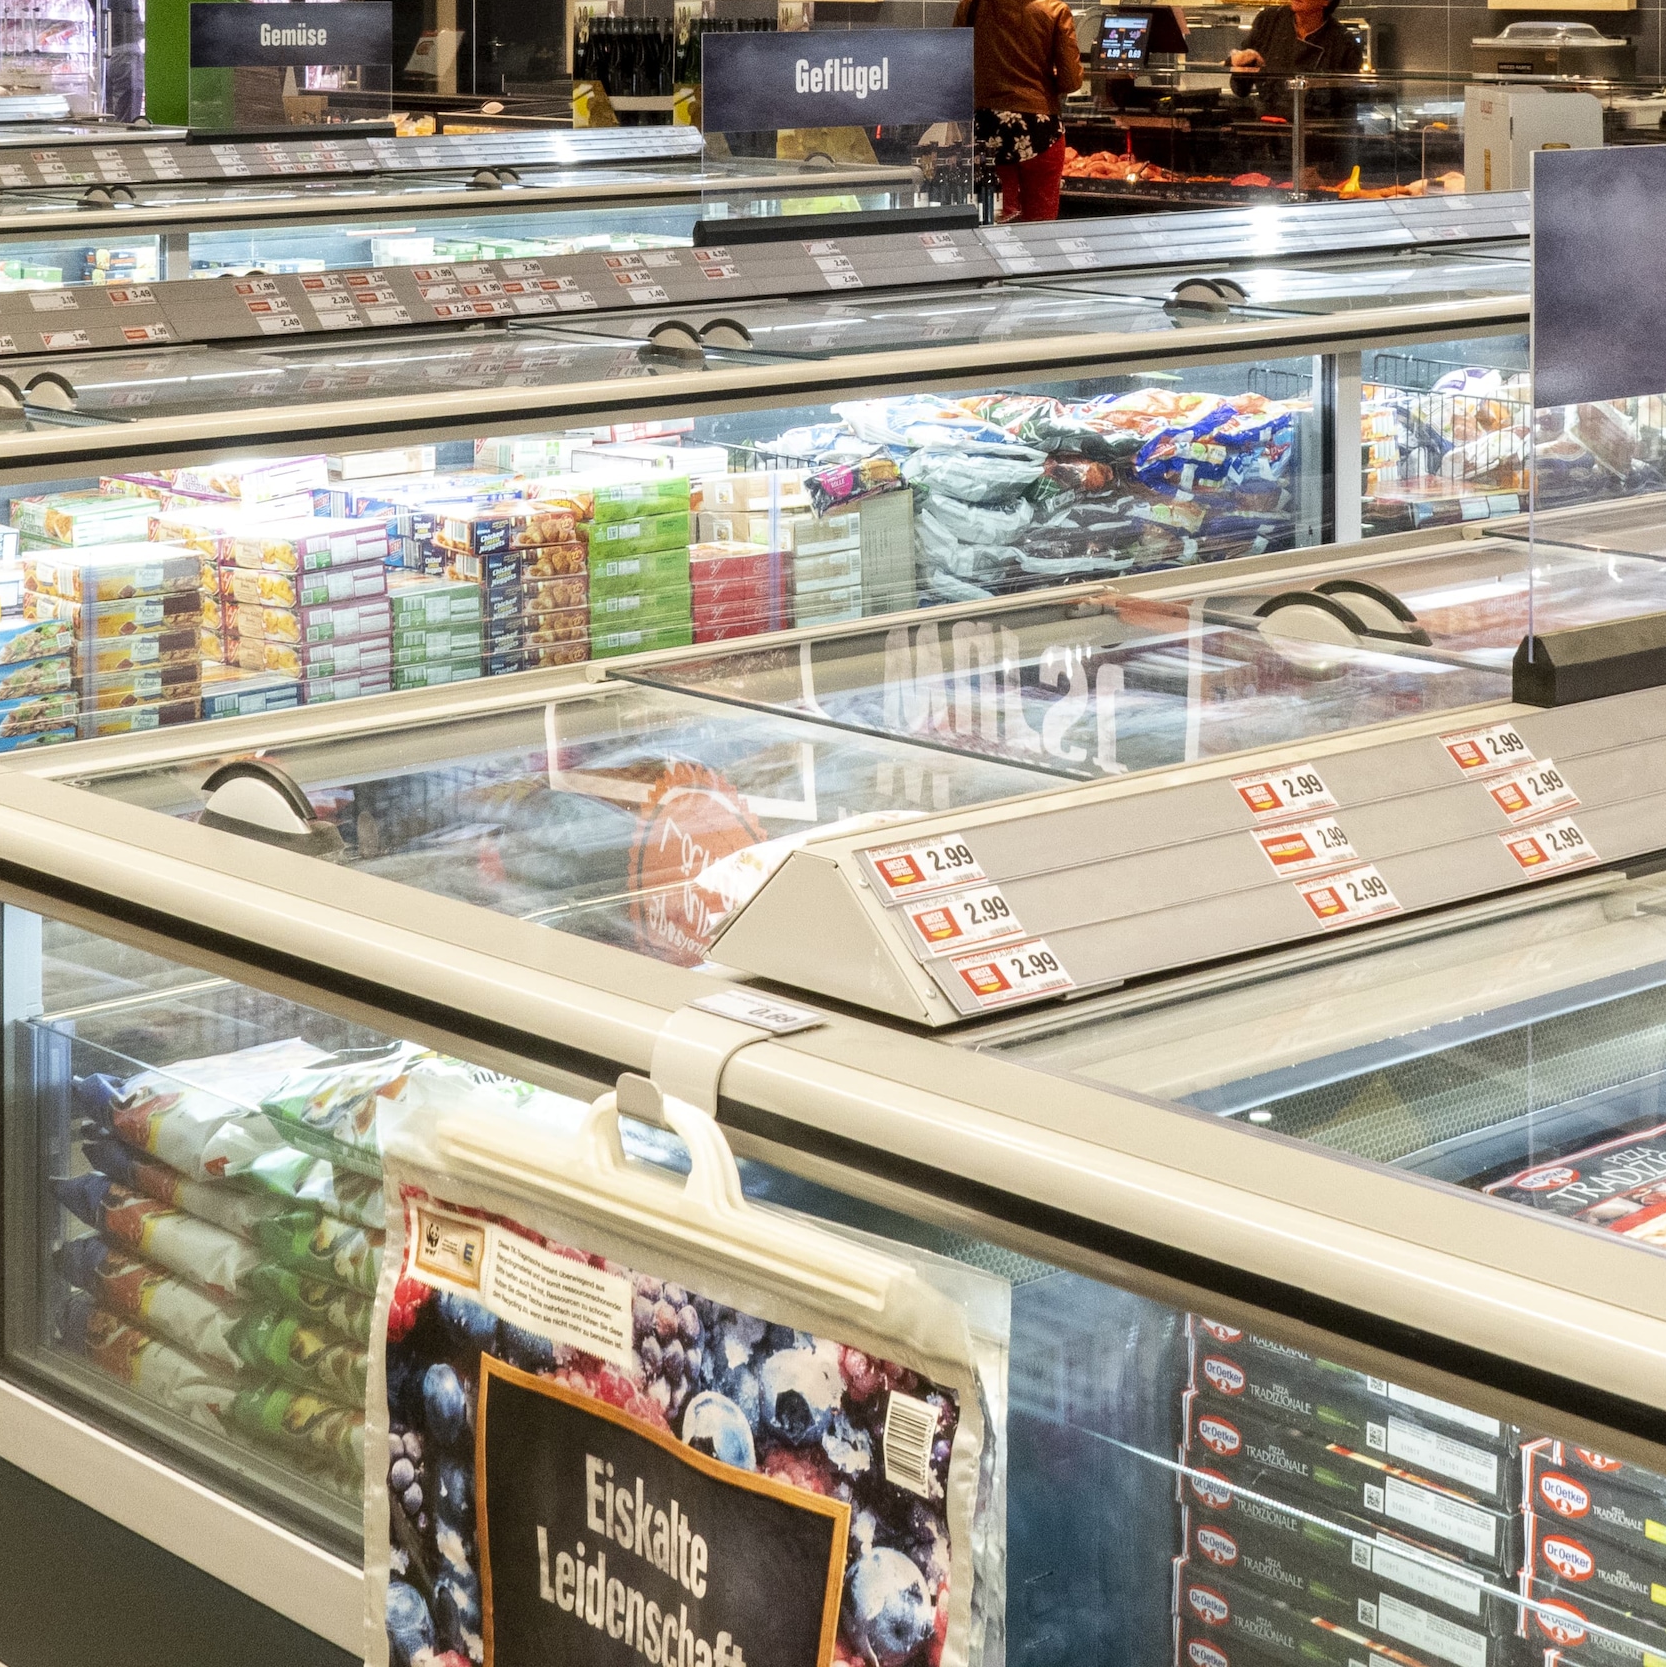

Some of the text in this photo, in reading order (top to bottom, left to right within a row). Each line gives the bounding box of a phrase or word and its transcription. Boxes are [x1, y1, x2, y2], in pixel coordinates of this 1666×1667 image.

[259, 22, 328, 48] Gemüse
[795, 56, 889, 97] Geflügel
[1486, 732, 1524, 755] 2.99
[1282, 774, 1323, 798] 2.99
[1527, 769, 1564, 796] 2.99
[1317, 826, 1349, 849] 2.99
[1546, 827, 1584, 851] 2.99
[926, 844, 974, 871] 2.99
[1346, 876, 1388, 902] 2.99
[963, 895, 1010, 925] 2.99
[1011, 951, 1060, 979] 2.99
[749, 1008, 798, 1023] 0.69
[1607, 1142, 1661, 1167] PIZZA
[1206, 1361, 1243, 1385] Dr.Oetker
[1249, 1384, 1313, 1415] TRADIZIONALE
[1201, 1423, 1238, 1446] Dr.Oetker
[1245, 1444, 1308, 1477] TRADIZIONALE
[1543, 1480, 1586, 1506] Dr.Oetker
[585, 1452, 709, 1599] Eiskalte
[1593, 1505, 1644, 1531] TRADIZIONALE
[1199, 1533, 1236, 1555] Dr.Oetker
[1546, 1544, 1590, 1570] Dr.Oetker
[1242, 1555, 1304, 1589] TRADIZIONALE
[1597, 1568, 1649, 1594] TRADIZIONALE
[537, 1525, 747, 1667] Leidenschaft
[1190, 1591, 1227, 1615] Dr.Oetker
[1233, 1615, 1295, 1649] TRADIZIONALE
[1190, 1646, 1227, 1667] Dr.Oetker
